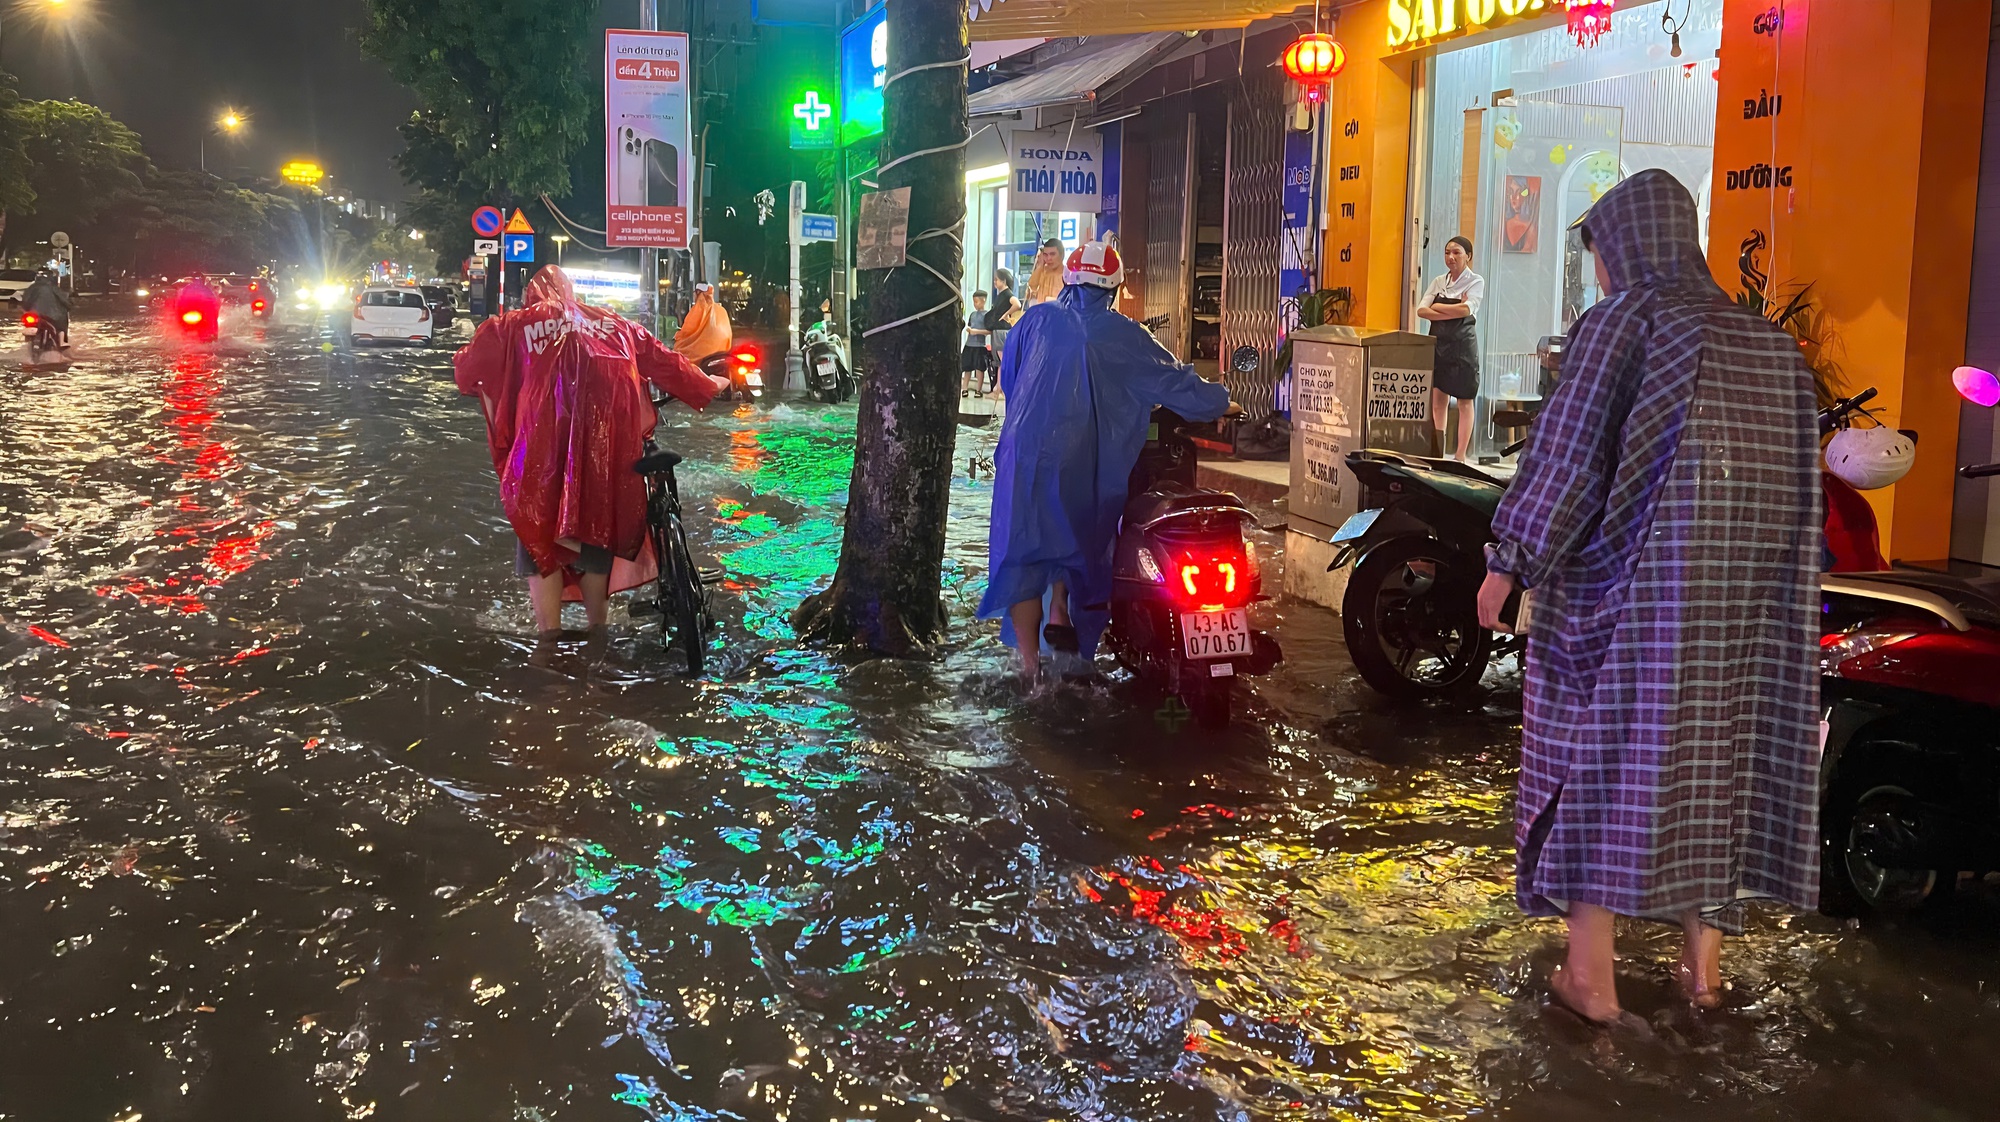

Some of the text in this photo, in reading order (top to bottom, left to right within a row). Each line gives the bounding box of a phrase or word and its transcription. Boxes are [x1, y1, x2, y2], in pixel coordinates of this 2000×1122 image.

[618, 61, 676, 80] đến 4 Triệu
[1743, 88, 1782, 120] ĐẦU
[1020, 148, 1093, 162] HONDA
[1015, 165, 1097, 195] THÁI HÒA
[611, 209, 683, 224] cellphone S
[514, 240, 528, 256] P
[1300, 367, 1332, 378] CHO VAY
[1373, 372, 1426, 382] CHO VAY
[1318, 380, 1334, 389] GÓP
[1401, 384, 1428, 394] GÓP
[1369, 400, 1424, 420] 0708.123.383
[1194, 613, 1238, 633] 43-AC
[1190, 633, 1246, 655] 070.67
